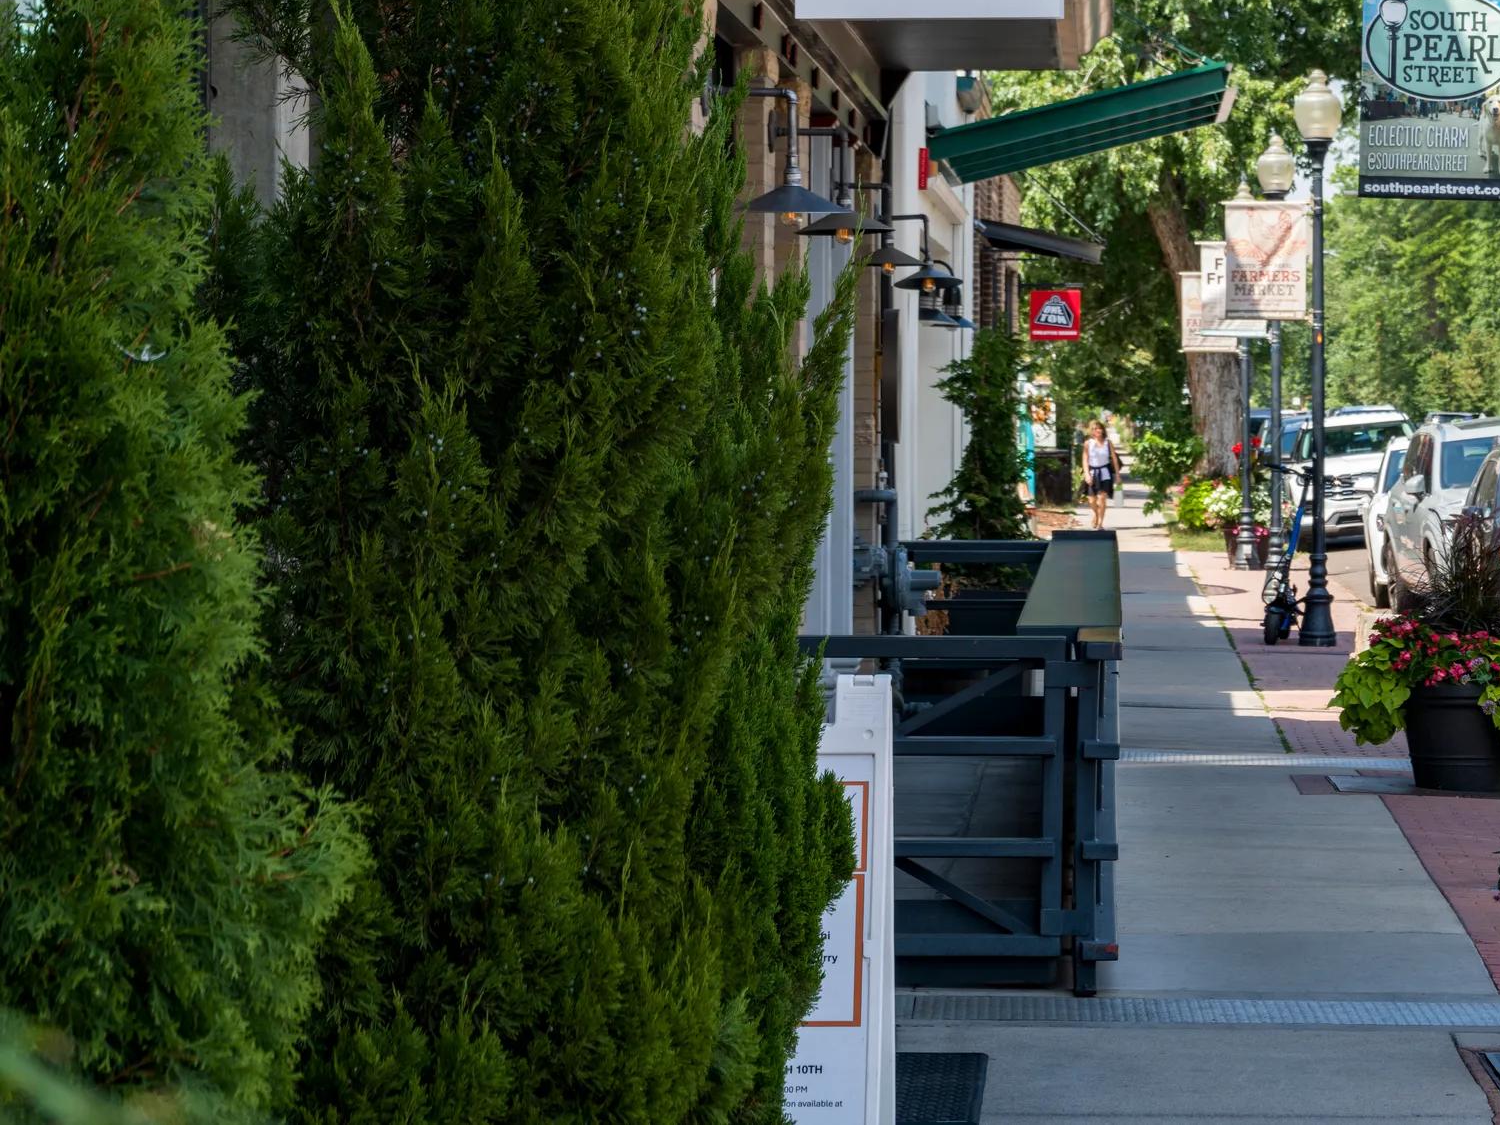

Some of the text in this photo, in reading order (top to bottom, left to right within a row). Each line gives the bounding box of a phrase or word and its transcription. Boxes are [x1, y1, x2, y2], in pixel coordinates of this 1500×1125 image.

[1409, 9, 1488, 32] SOUTH
[1403, 64, 1479, 87] STREET
[1368, 124, 1469, 148] ECLECTIC CHARM
[1367, 152, 1468, 172] @SOUTHPEARLSTREET
[1231, 270, 1301, 283] FARMERS
[1234, 284, 1296, 296] MARKET
[796, 1065, 823, 1075] 10TH
[795, 1086, 808, 1094] PM
[797, 1100, 834, 1108] available
[834, 1100, 843, 1108] at
